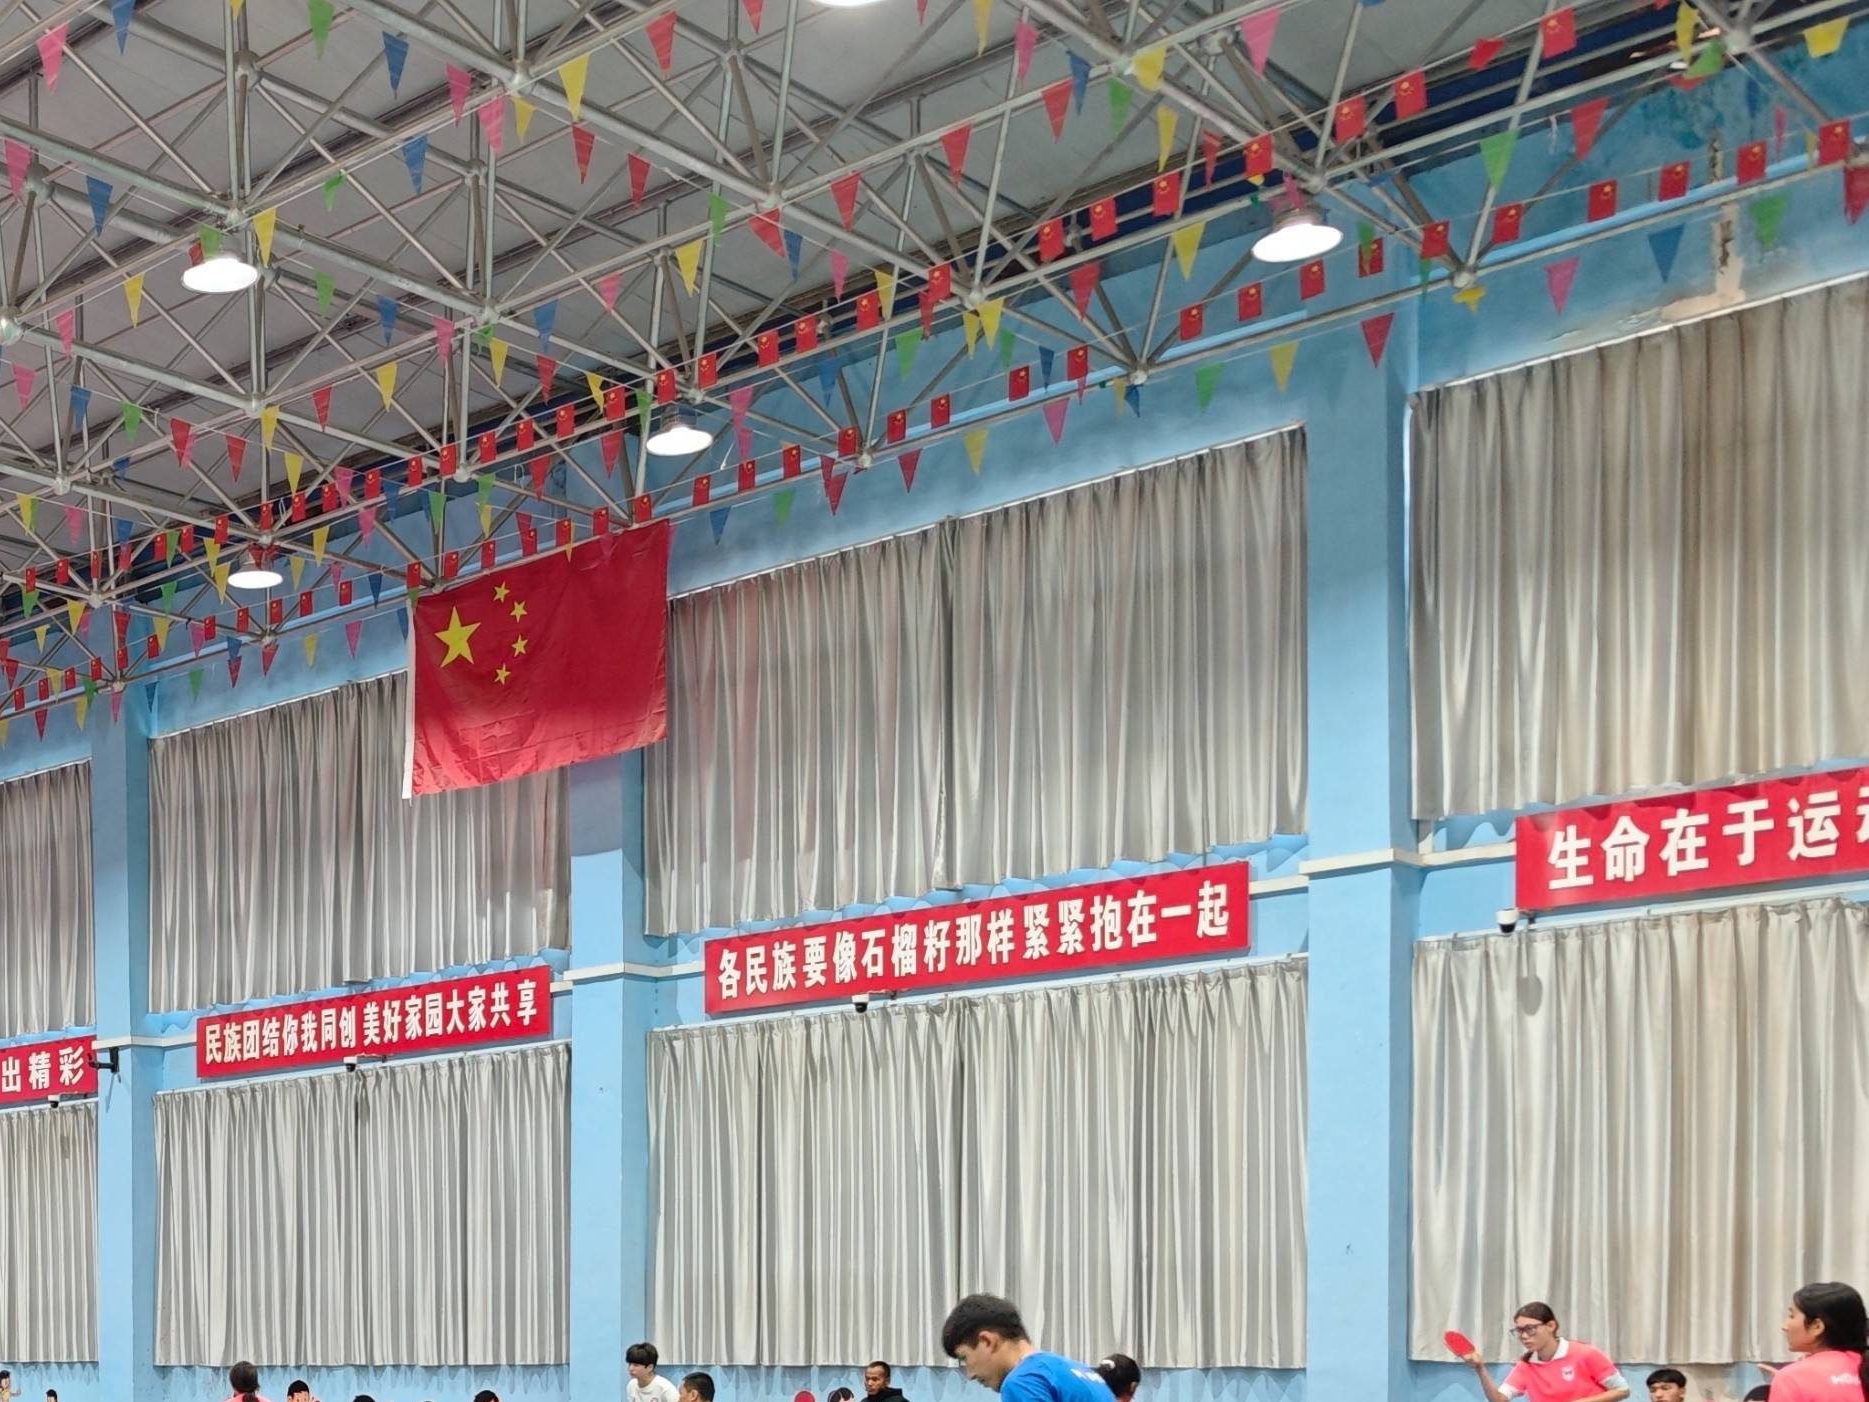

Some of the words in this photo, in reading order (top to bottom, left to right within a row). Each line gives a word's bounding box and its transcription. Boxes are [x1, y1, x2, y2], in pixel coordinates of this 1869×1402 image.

[1547, 787, 1869, 890] 生命在于运
[718, 880, 1229, 1000] 各民族要像石榴籽那样紧紧抱在一起
